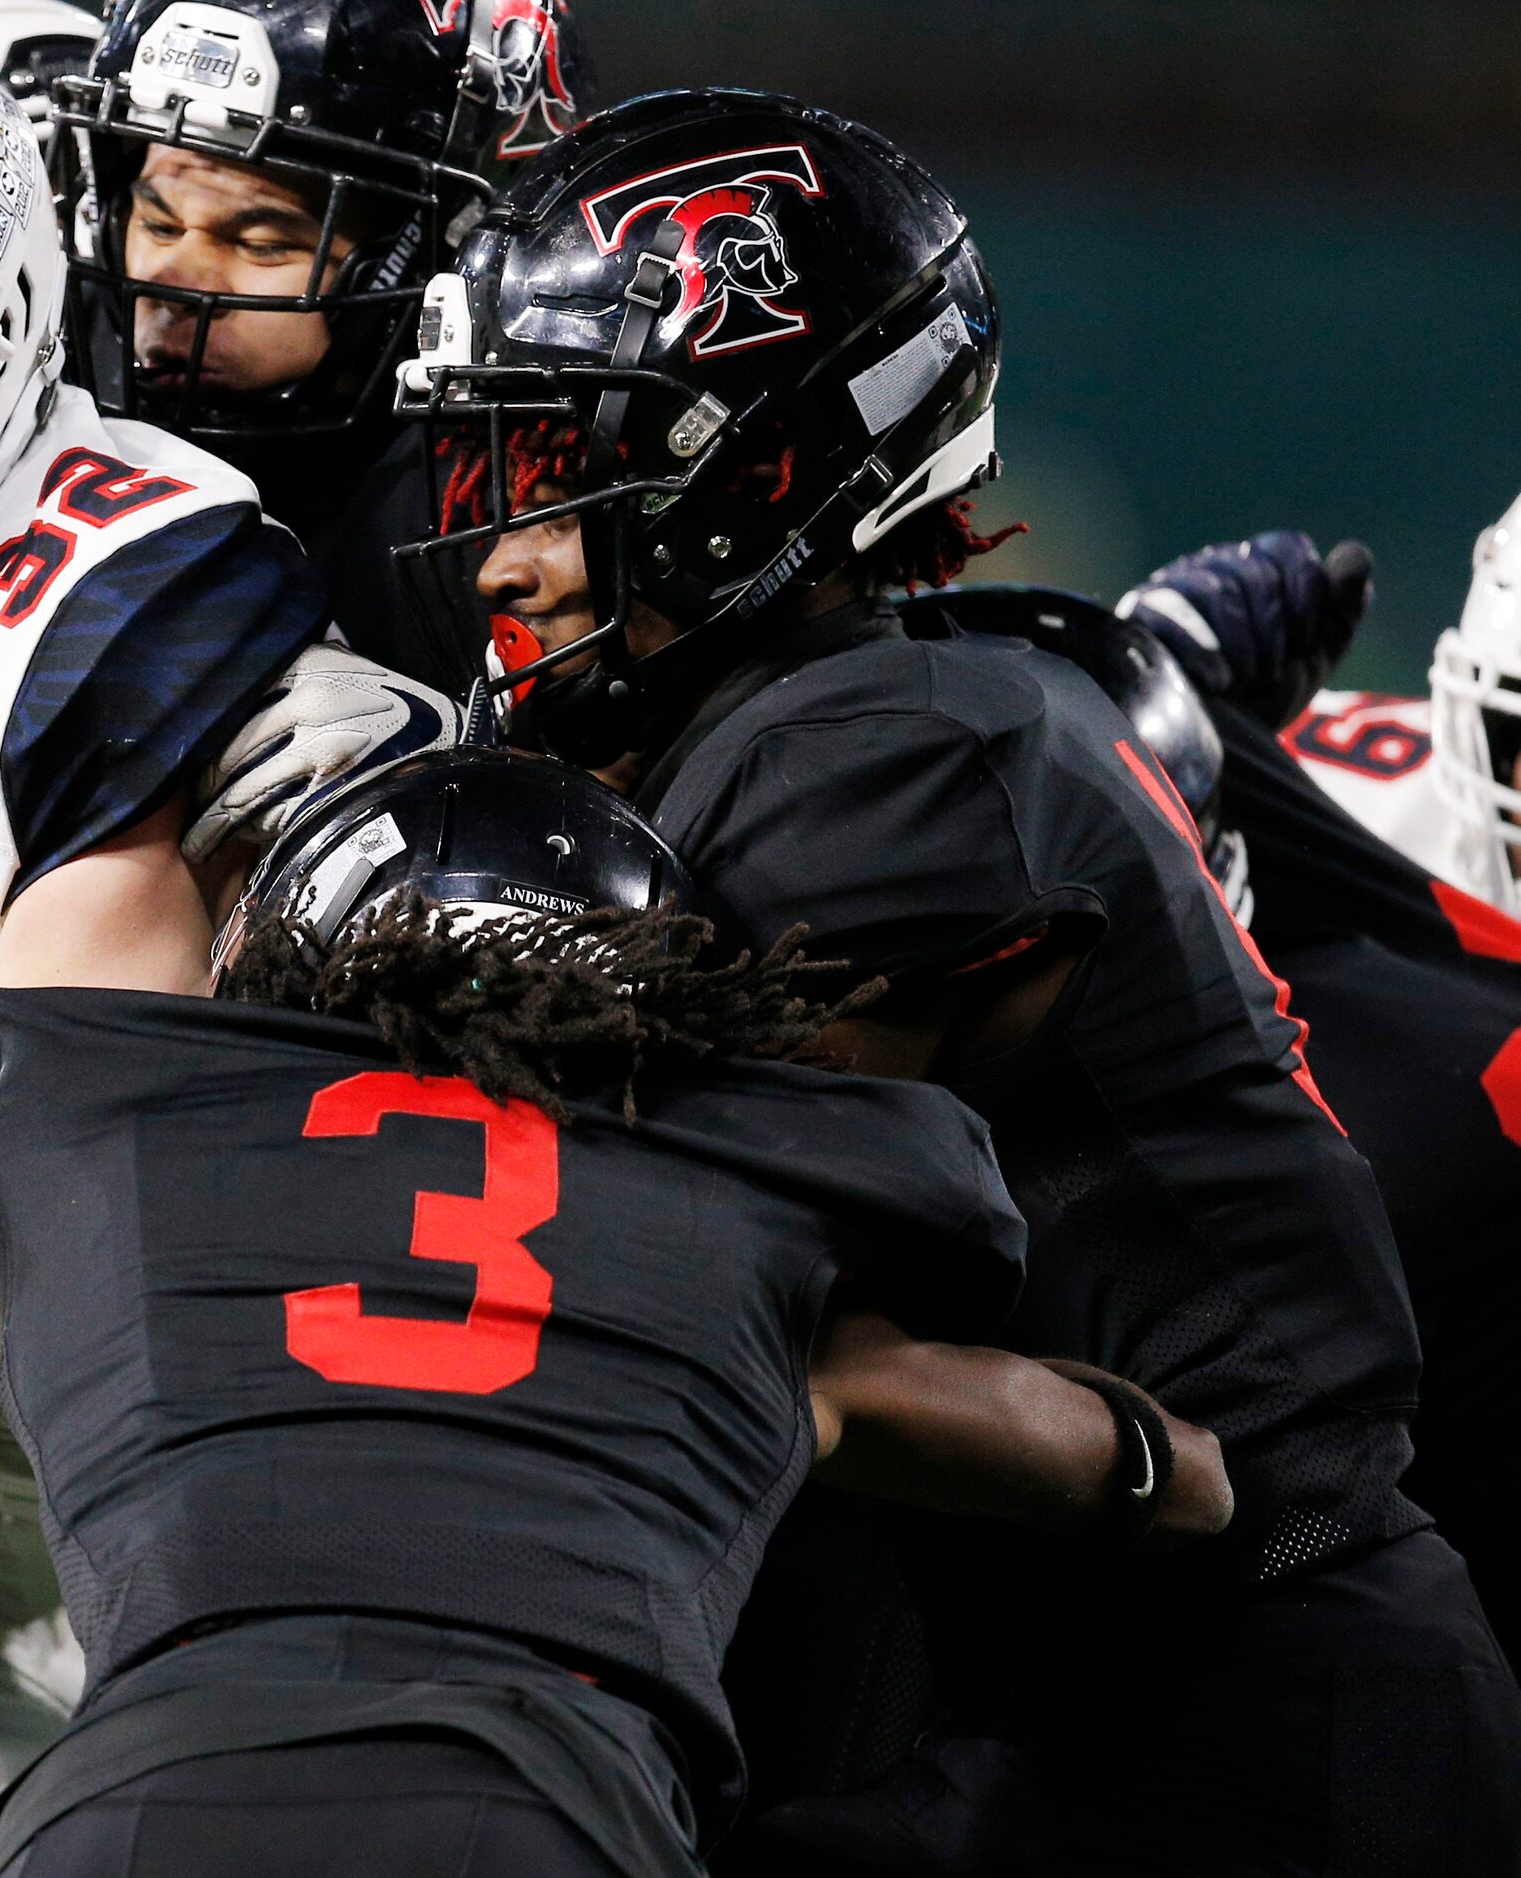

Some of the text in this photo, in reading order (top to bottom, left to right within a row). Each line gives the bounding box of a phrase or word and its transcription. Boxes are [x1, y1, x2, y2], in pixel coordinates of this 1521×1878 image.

[162, 47, 233, 76] schutt
[736, 535, 814, 620] schutt
[500, 885, 585, 916] ANDREWS
[283, 1071, 559, 1395] 3
